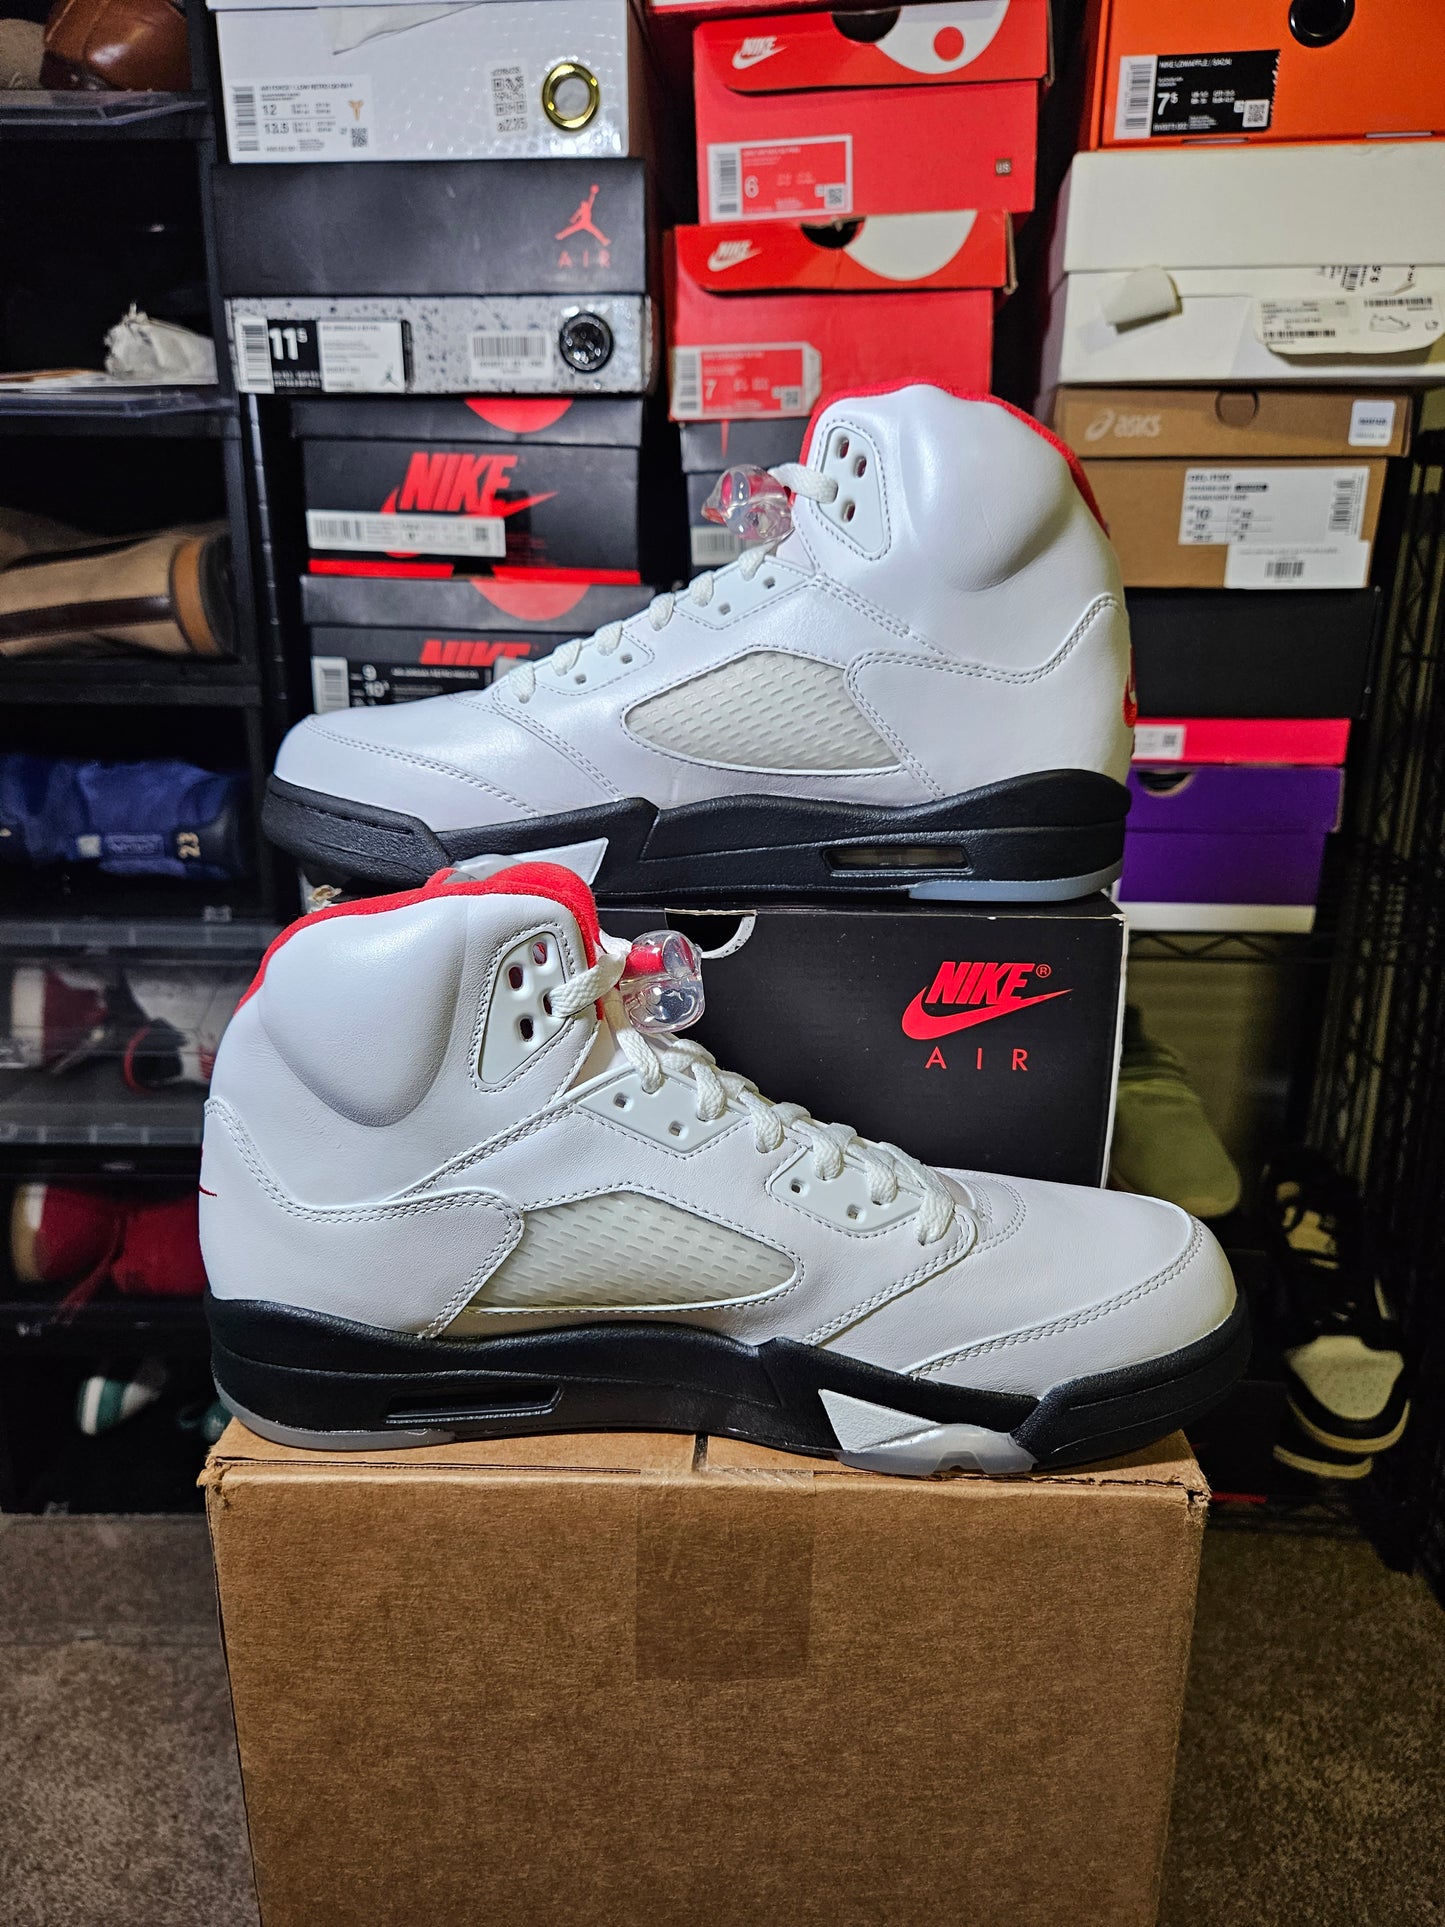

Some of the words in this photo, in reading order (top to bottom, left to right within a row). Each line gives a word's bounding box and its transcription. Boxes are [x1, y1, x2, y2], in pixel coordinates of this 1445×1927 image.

[744, 175, 760, 198] 6
[557, 249, 611, 270] AIR
[705, 379, 717, 401] 7
[399, 452, 519, 514] NIKE
[925, 1046, 1028, 1071] AIR
